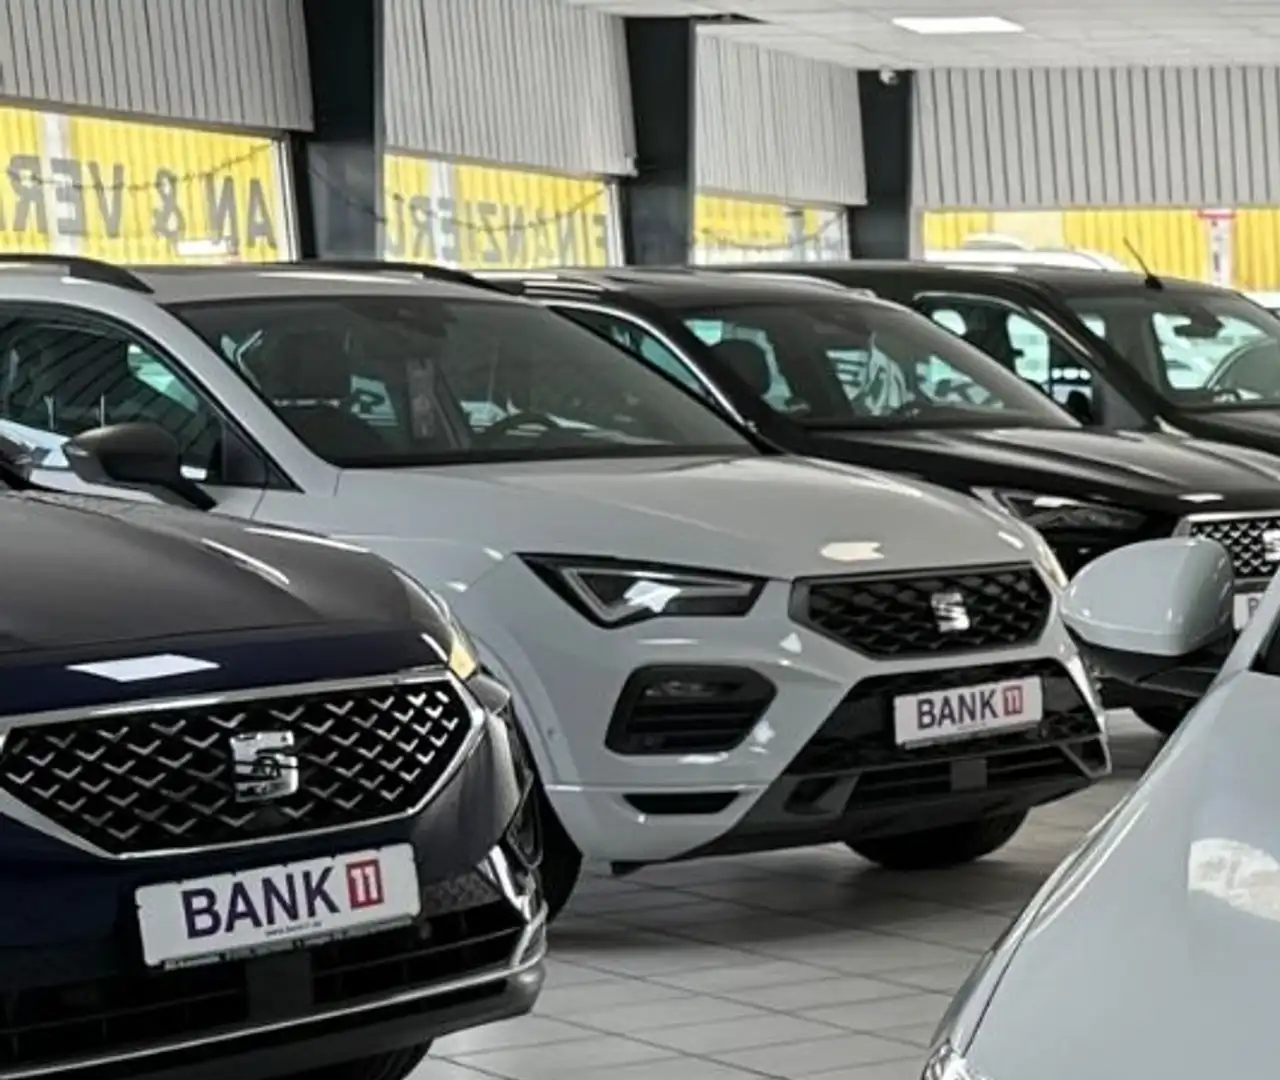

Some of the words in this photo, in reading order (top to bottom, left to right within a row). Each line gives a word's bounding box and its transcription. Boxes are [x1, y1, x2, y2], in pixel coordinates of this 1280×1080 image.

[917, 689, 998, 730] BANK
[181, 866, 341, 939] BANK
[349, 864, 380, 905] 11
